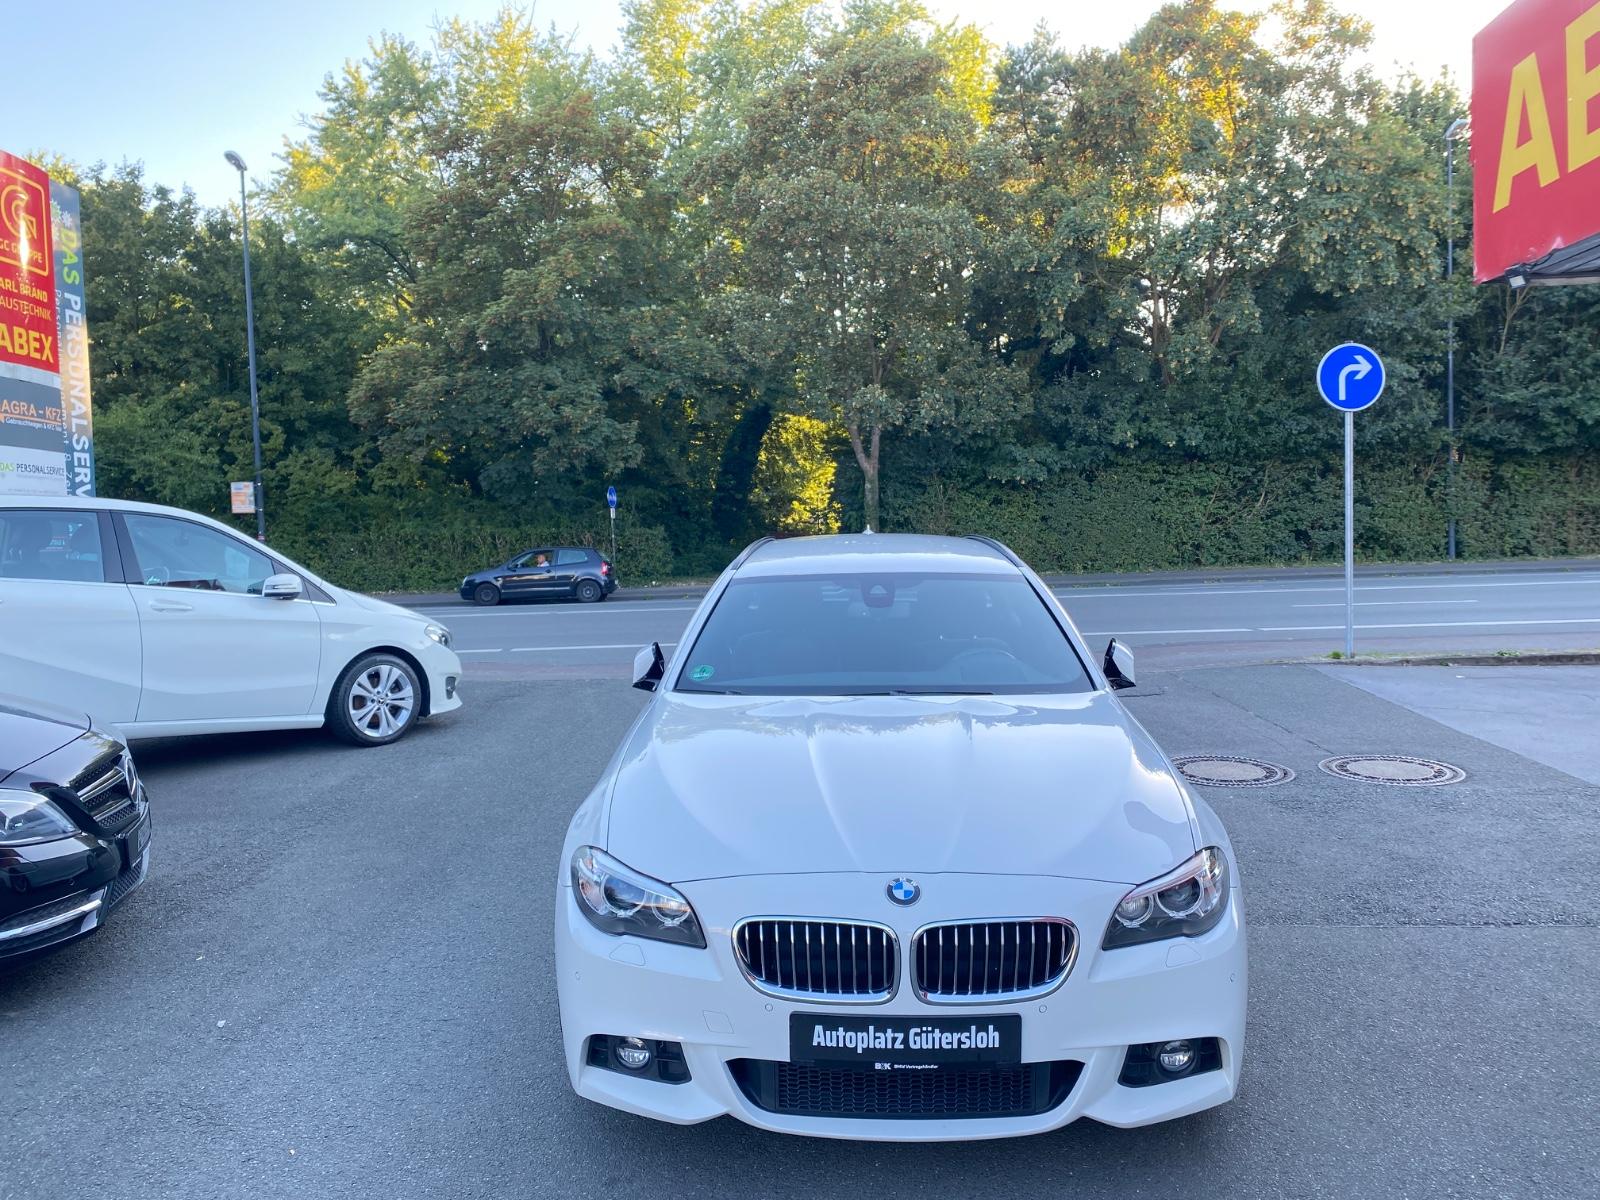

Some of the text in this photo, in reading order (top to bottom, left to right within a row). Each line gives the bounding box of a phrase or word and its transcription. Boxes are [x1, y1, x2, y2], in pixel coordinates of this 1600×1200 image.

[11, 242, 43, 264] GPPE
[61, 229, 80, 285] DAS
[0, 323, 54, 364] ABEX
[1, 399, 37, 417] AGRA
[812, 1025, 1000, 1053] Autoplatz Gütersloh
